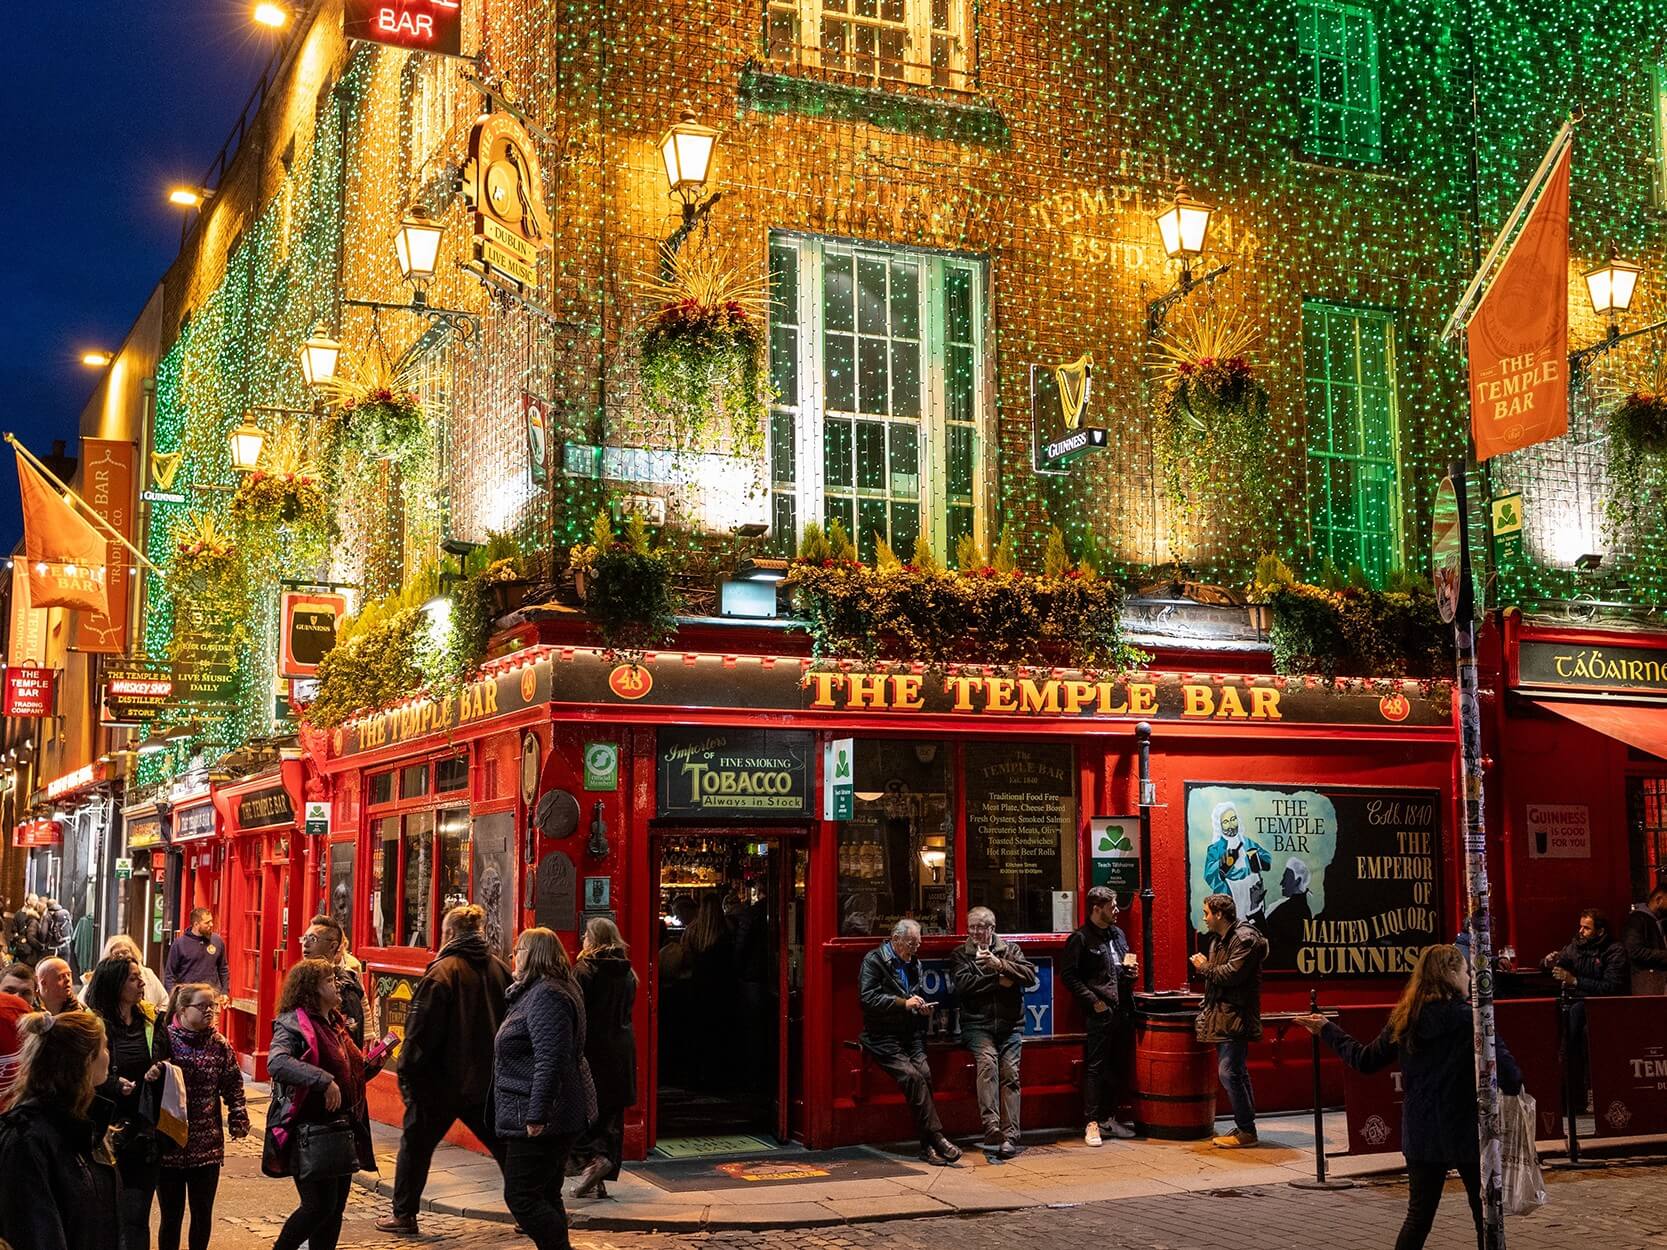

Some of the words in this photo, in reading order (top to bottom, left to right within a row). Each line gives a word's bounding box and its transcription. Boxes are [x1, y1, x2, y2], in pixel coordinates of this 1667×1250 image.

[379, 8, 433, 38] BAR
[495, 226, 527, 255] DUBLIN
[488, 247, 506, 268] LIVE
[508, 259, 533, 282] MUSIC
[1498, 352, 1535, 375] THE
[1476, 360, 1559, 404] TEMPLE
[1493, 391, 1535, 421] BAR
[1048, 432, 1087, 458] GUINNESS
[95, 470, 109, 504] BAR
[57, 577, 93, 592] BAR
[296, 623, 331, 633] GUINNESS
[21, 670, 40, 679] THE
[126, 672, 159, 680] TEMPLE
[178, 673, 200, 682] LIVE
[201, 673, 233, 682] MUSIC
[11, 679, 49, 688] TEMPLE
[112, 681, 149, 693] WHISKEY
[150, 682, 172, 694] SHOP
[190, 684, 220, 692] DAILY
[18, 688, 39, 697] BAR
[118, 696, 167, 704] DISTILLERY
[616, 672, 644, 691] 48
[803, 672, 925, 712] THE
[944, 675, 1159, 718] TEMPLE
[1181, 684, 1283, 721] BAR
[1382, 699, 1402, 715] 48
[14, 701, 43, 709] TRADING
[128, 709, 155, 717] STORE
[358, 715, 386, 749] THE
[390, 696, 452, 741] TEMPLE
[459, 679, 498, 722] BAR
[665, 736, 727, 763] Importers
[720, 757, 744, 768] FINE
[745, 757, 791, 769] SMOKING
[982, 761, 1036, 778] TEMPLE
[1038, 765, 1064, 780] BAR
[680, 762, 792, 803] TOBACCO
[704, 796, 746, 807] Always
[752, 796, 763, 806] in
[767, 796, 801, 807] Stock
[989, 792, 1025, 801] Traditional
[1026, 793, 1043, 801] Food
[1044, 793, 1060, 801] Fare
[982, 803, 999, 811] Meat
[1020, 804, 1045, 812] Cheese
[1272, 799, 1309, 817] THE
[1404, 804, 1433, 826] 1840
[969, 815, 989, 823] Fresh
[1018, 815, 1045, 823] Smoked
[1046, 815, 1071, 823] Salmon
[1529, 808, 1587, 825] GUINNESS
[1255, 816, 1326, 835] TEMPLE
[1551, 827, 1559, 836] IS
[1561, 827, 1585, 836] GOOD
[988, 837, 1014, 845] Toasted
[1015, 837, 1054, 846] Sandwiches
[1273, 835, 1310, 853] BAR
[1396, 831, 1431, 855] THE
[1552, 838, 1567, 847] FOR
[1569, 838, 1586, 847] YOU
[987, 848, 999, 856] Hot
[1000, 848, 1020, 856] Roast
[1021, 848, 1037, 856] Beef
[1038, 848, 1055, 856] Rolls
[1356, 856, 1433, 880] EMPEROR
[1413, 882, 1433, 905] OF
[1302, 919, 1369, 944] MALTED
[1371, 906, 1437, 939] LIQUORS
[1297, 946, 1424, 974] GUINNES
